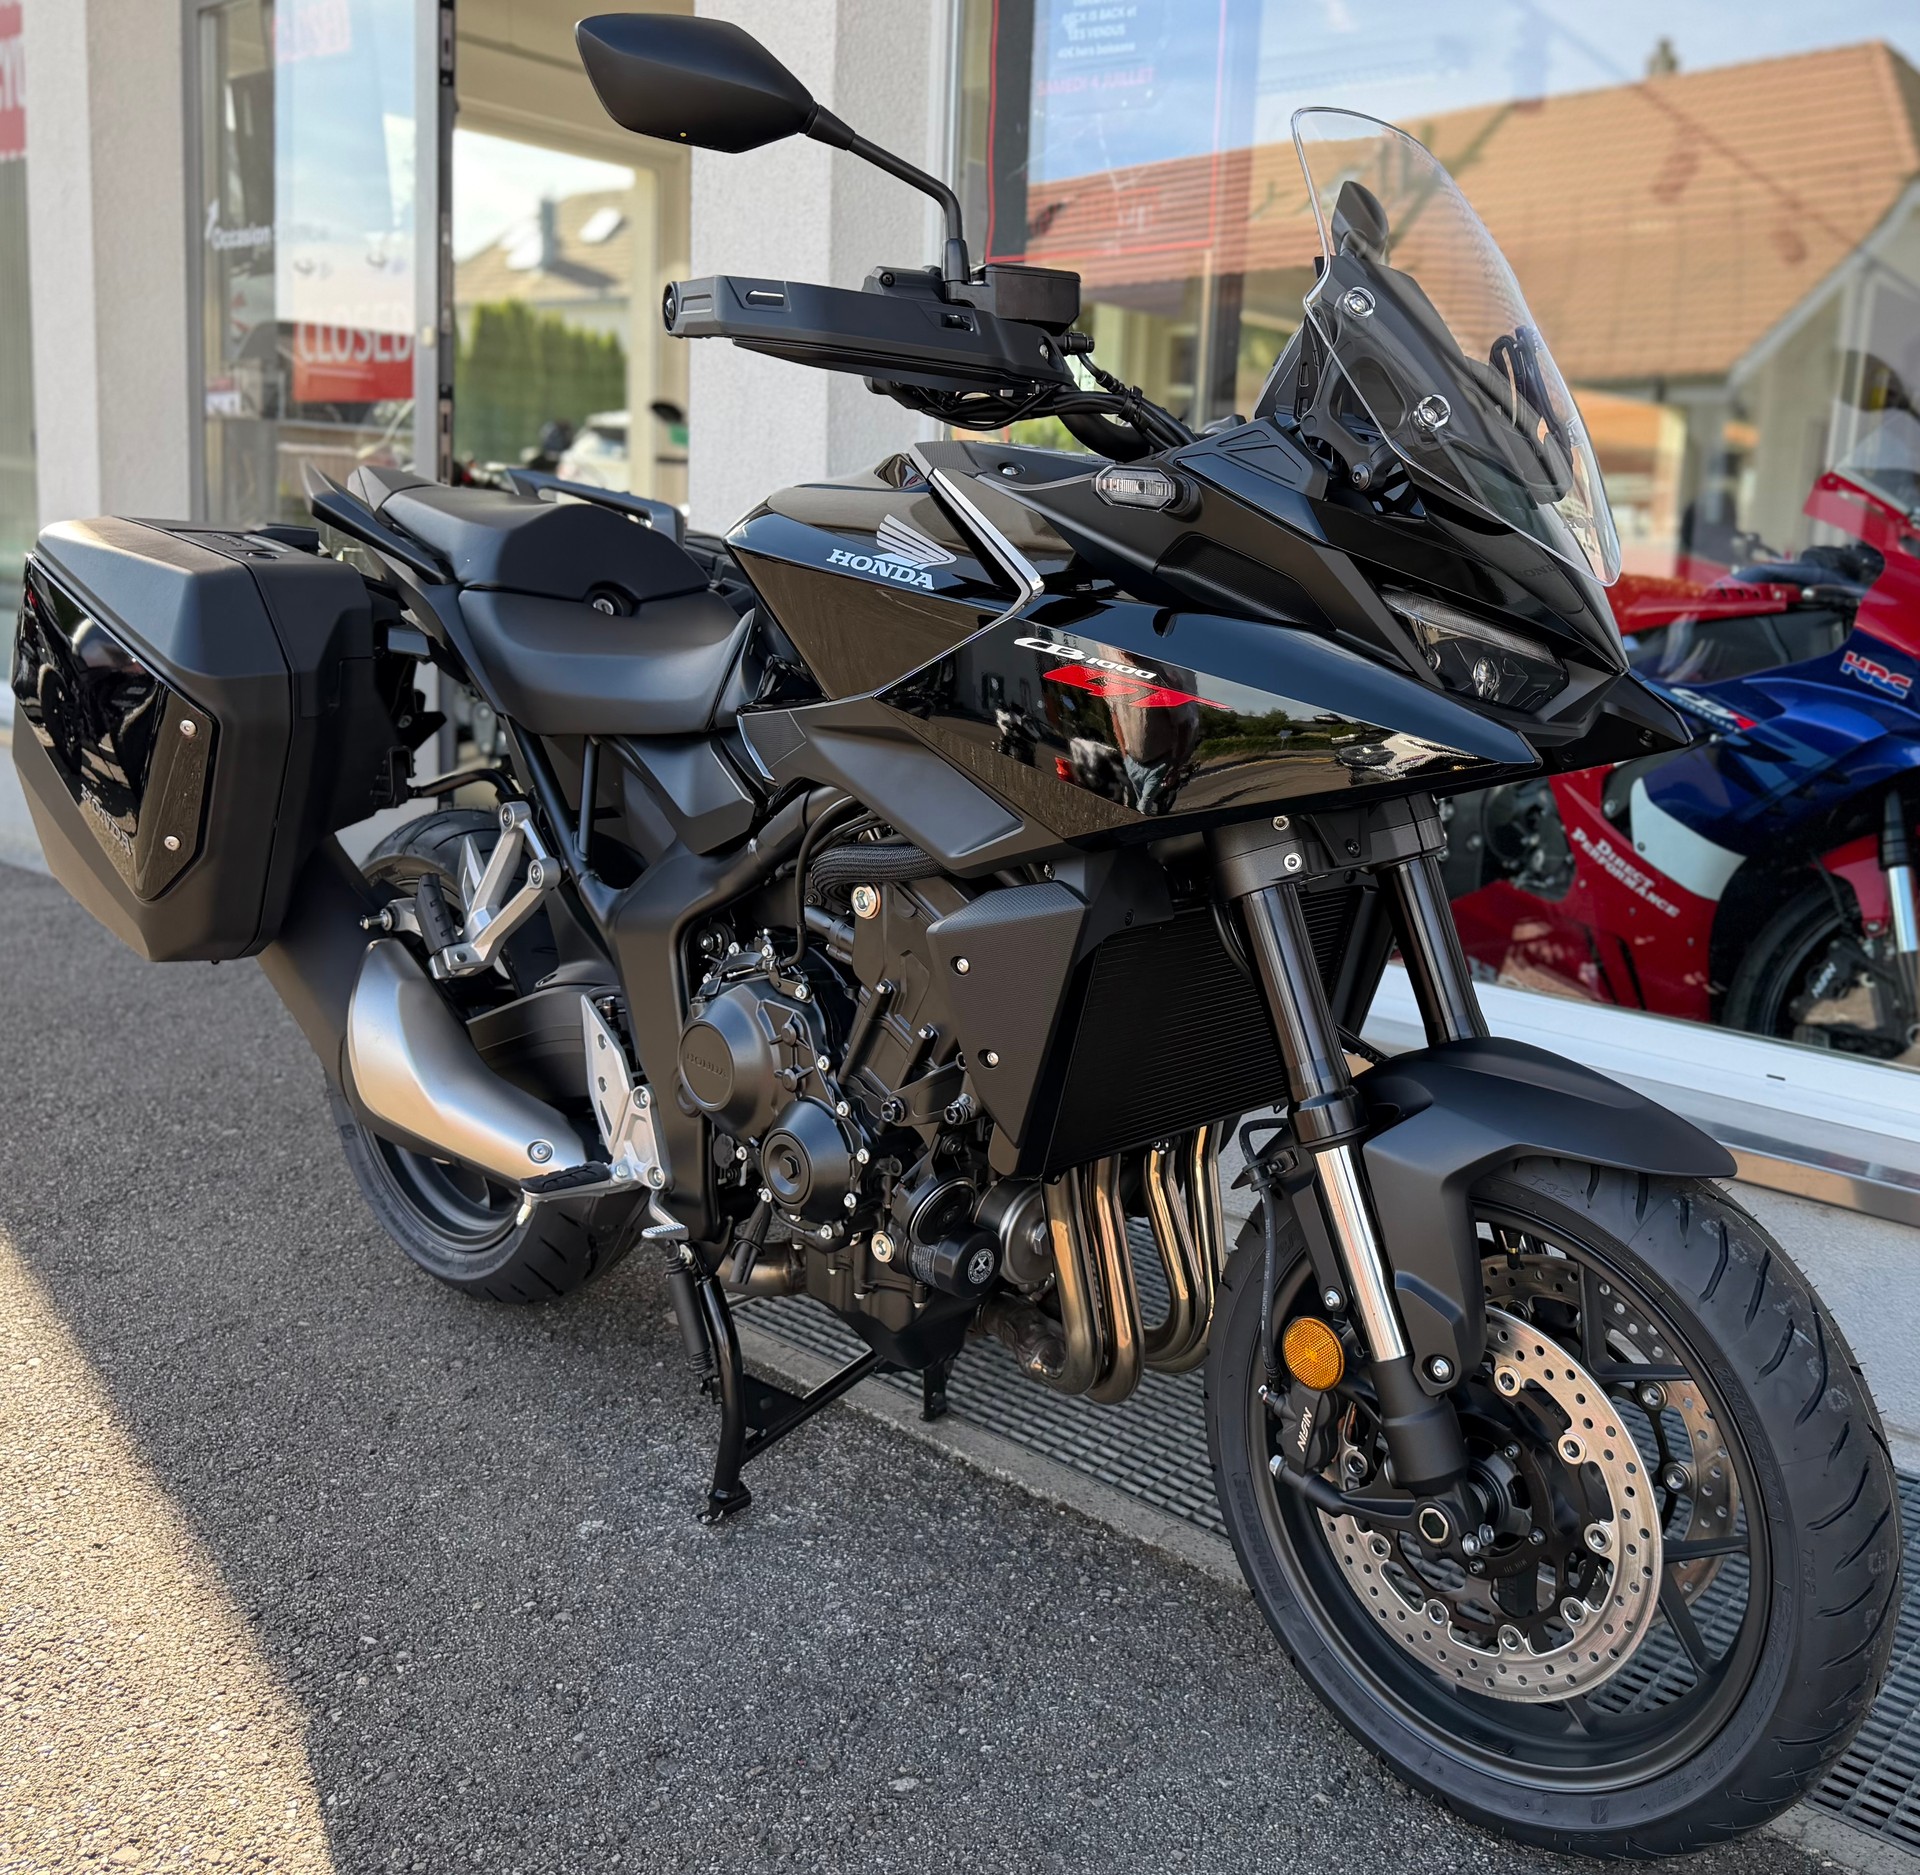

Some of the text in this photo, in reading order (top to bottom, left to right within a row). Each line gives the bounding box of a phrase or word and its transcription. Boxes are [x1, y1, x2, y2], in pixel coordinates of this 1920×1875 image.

[826, 548, 935, 590] HONDA
[1840, 650, 1913, 699] HRC
[80, 783, 134, 857] HONDA
[1571, 826, 1681, 918] PERFORMANCE
[1595, 837, 1656, 890] DIRECT
